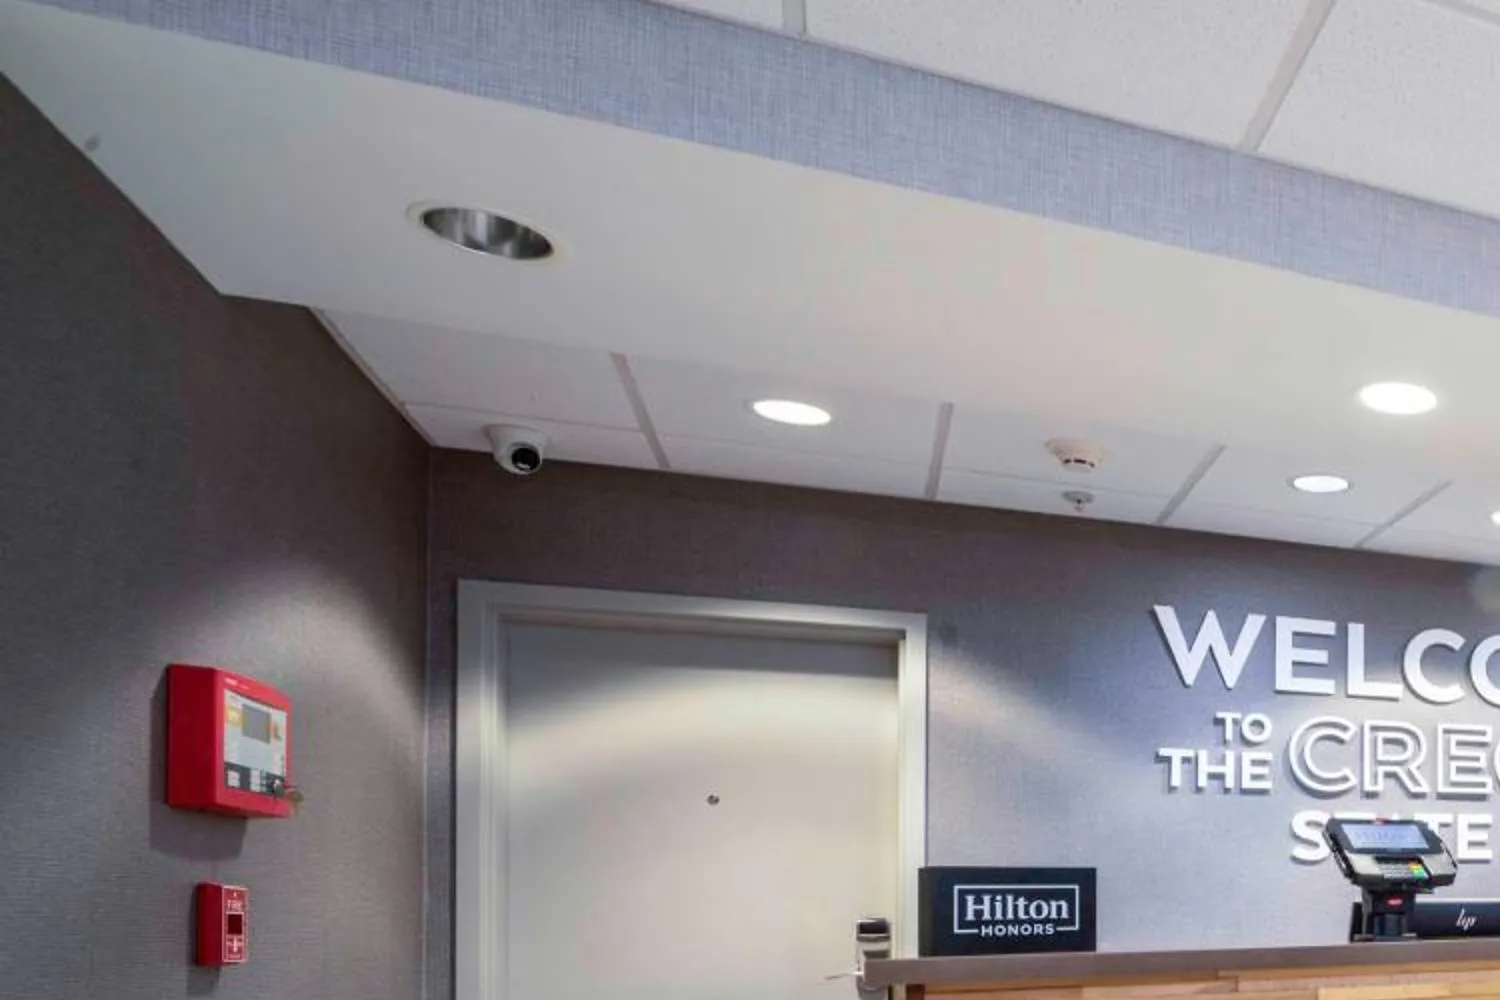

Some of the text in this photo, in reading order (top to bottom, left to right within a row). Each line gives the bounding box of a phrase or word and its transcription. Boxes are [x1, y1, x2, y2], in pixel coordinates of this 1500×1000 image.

[1214, 711, 1272, 744] TO
[1157, 747, 1273, 791] THE
[965, 893, 1070, 921] Hilton
[981, 922, 1056, 937] HONORS
